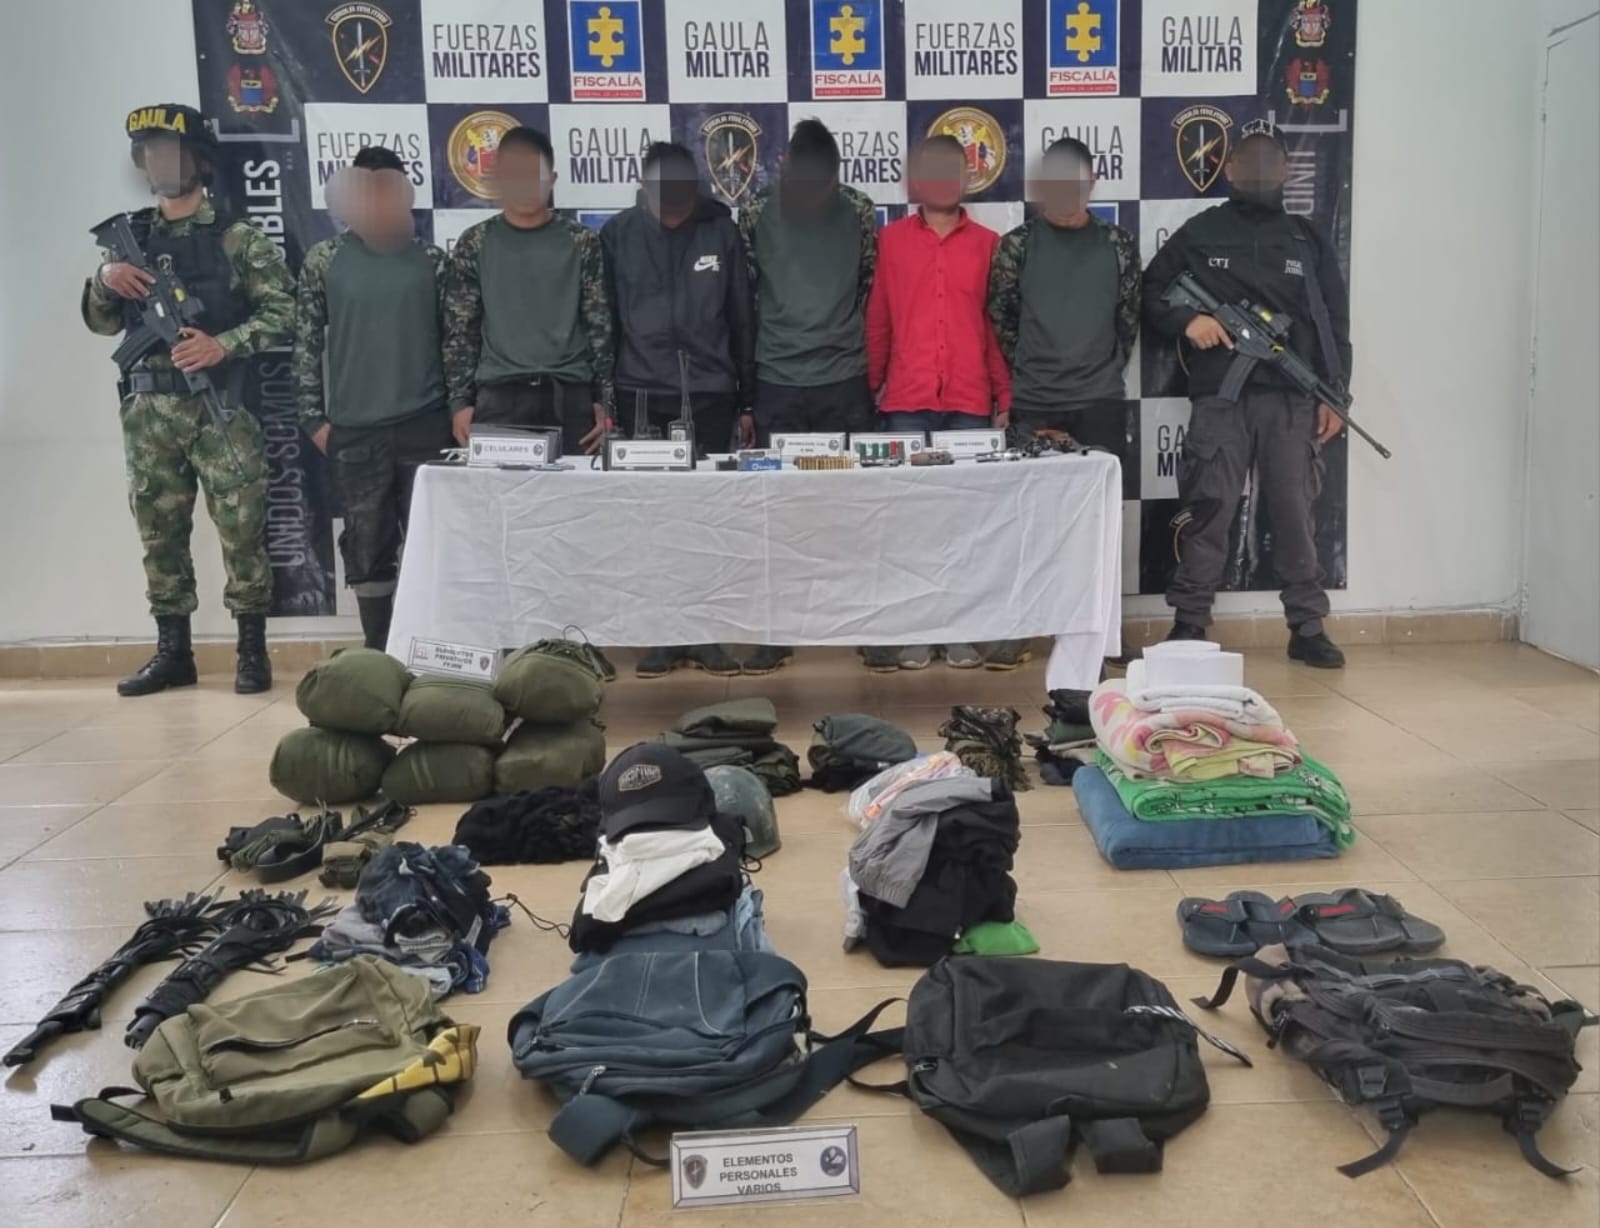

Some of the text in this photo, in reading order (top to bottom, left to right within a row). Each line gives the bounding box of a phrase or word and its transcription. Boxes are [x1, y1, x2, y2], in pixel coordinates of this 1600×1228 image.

[433, 24, 537, 51] FUERZAS
[684, 21, 769, 51] GAULA
[915, 22, 1015, 49] FUERZAS
[1162, 16, 1243, 46] GAULA
[432, 52, 541, 78] MILITARES
[686, 51, 769, 78] MILITAR
[914, 50, 1018, 76] MILITARES
[1161, 46, 1242, 72] MILITAR
[574, 75, 642, 87] FISCALÍA
[814, 72, 882, 85] FISCALÍA
[1049, 68, 1116, 82] FISCALÍA
[129, 108, 187, 134] GAULA
[569, 127, 650, 157] GAULA
[832, 131, 899, 157] RZAS
[570, 157, 642, 184] MILITA
[840, 157, 902, 183] TARES
[722, 1153, 794, 1168] ELEMENTOS
[719, 1166, 798, 1183] PERSONALES
[737, 1183, 782, 1196] VARIOS
